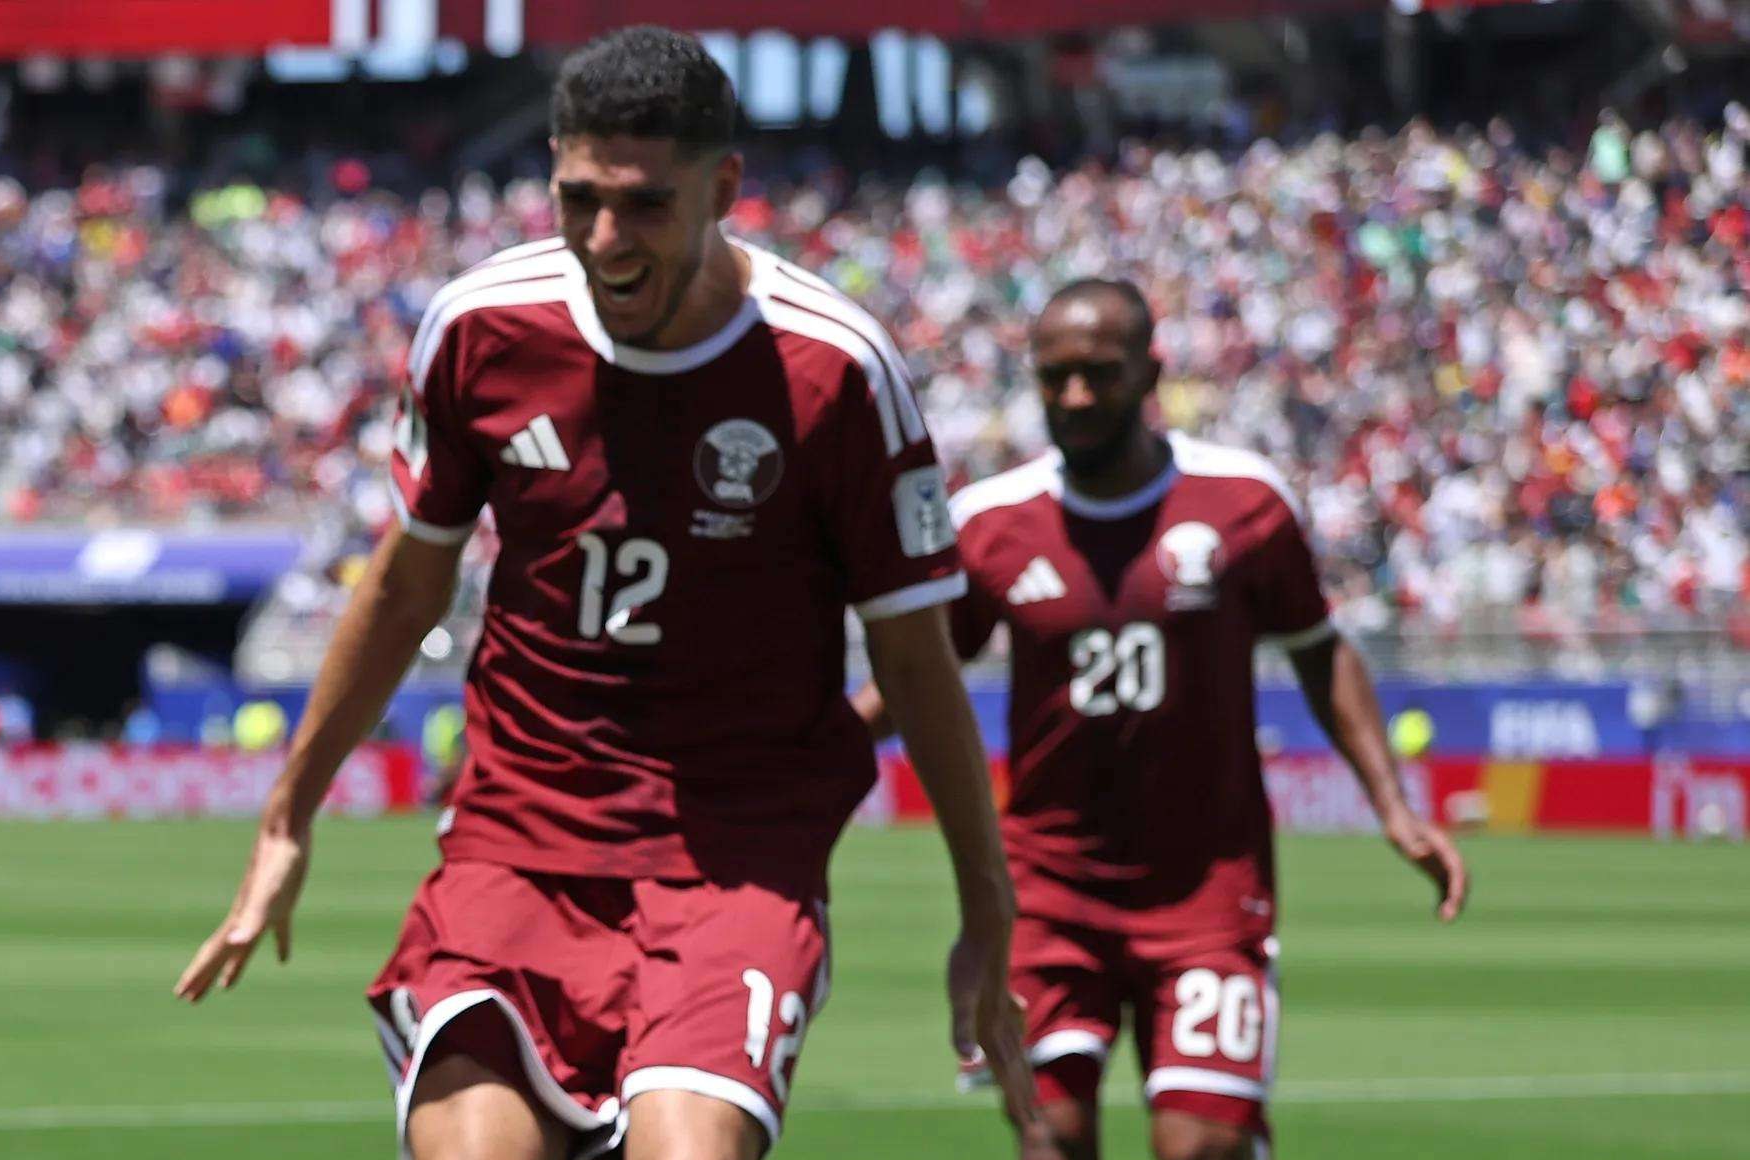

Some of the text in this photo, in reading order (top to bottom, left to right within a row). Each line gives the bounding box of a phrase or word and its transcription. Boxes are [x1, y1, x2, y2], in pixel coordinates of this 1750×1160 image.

[578, 531, 669, 645] 12
[1070, 622, 1164, 716] 20
[742, 968, 806, 1101] 12
[1172, 968, 1264, 1062] 20
